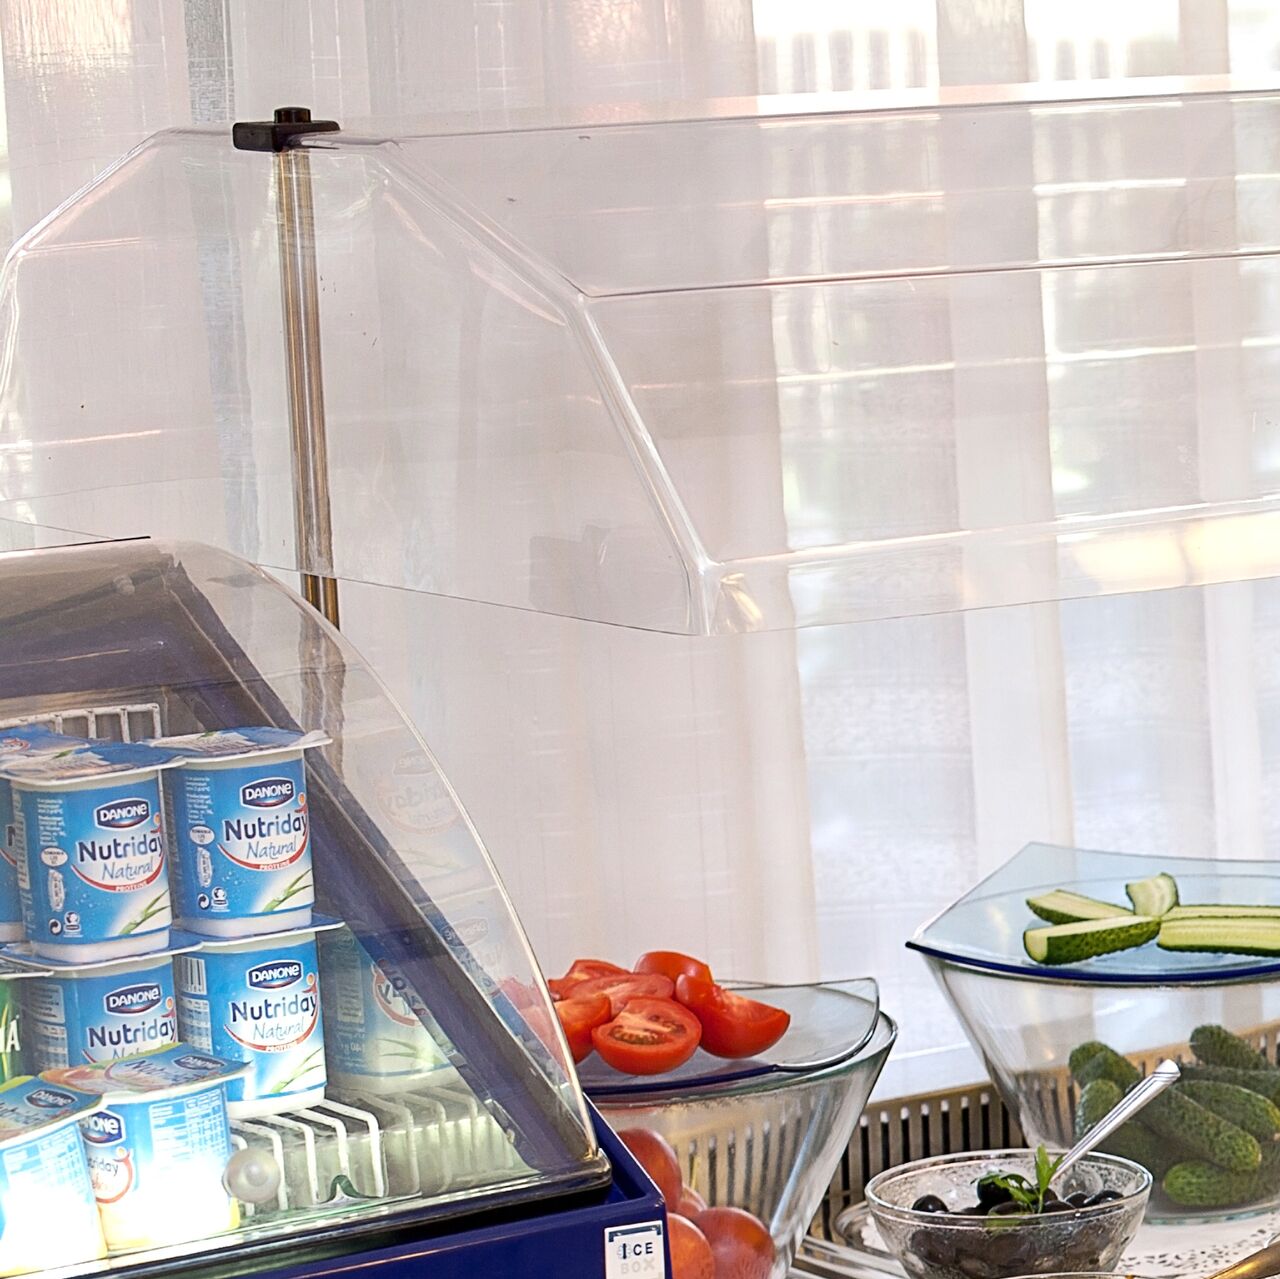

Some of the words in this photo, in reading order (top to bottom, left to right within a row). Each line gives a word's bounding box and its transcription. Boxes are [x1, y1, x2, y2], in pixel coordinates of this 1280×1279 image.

[225, 814, 308, 841] Nutriday
[246, 836, 297, 860] Natural
[102, 856, 153, 881] Natural
[231, 994, 317, 1022] Nutriday
[89, 1018, 176, 1048] Nutriday
[253, 1017, 304, 1041] Natural
[621, 1241, 654, 1260] ICE
[620, 1257, 655, 1274] BOX
